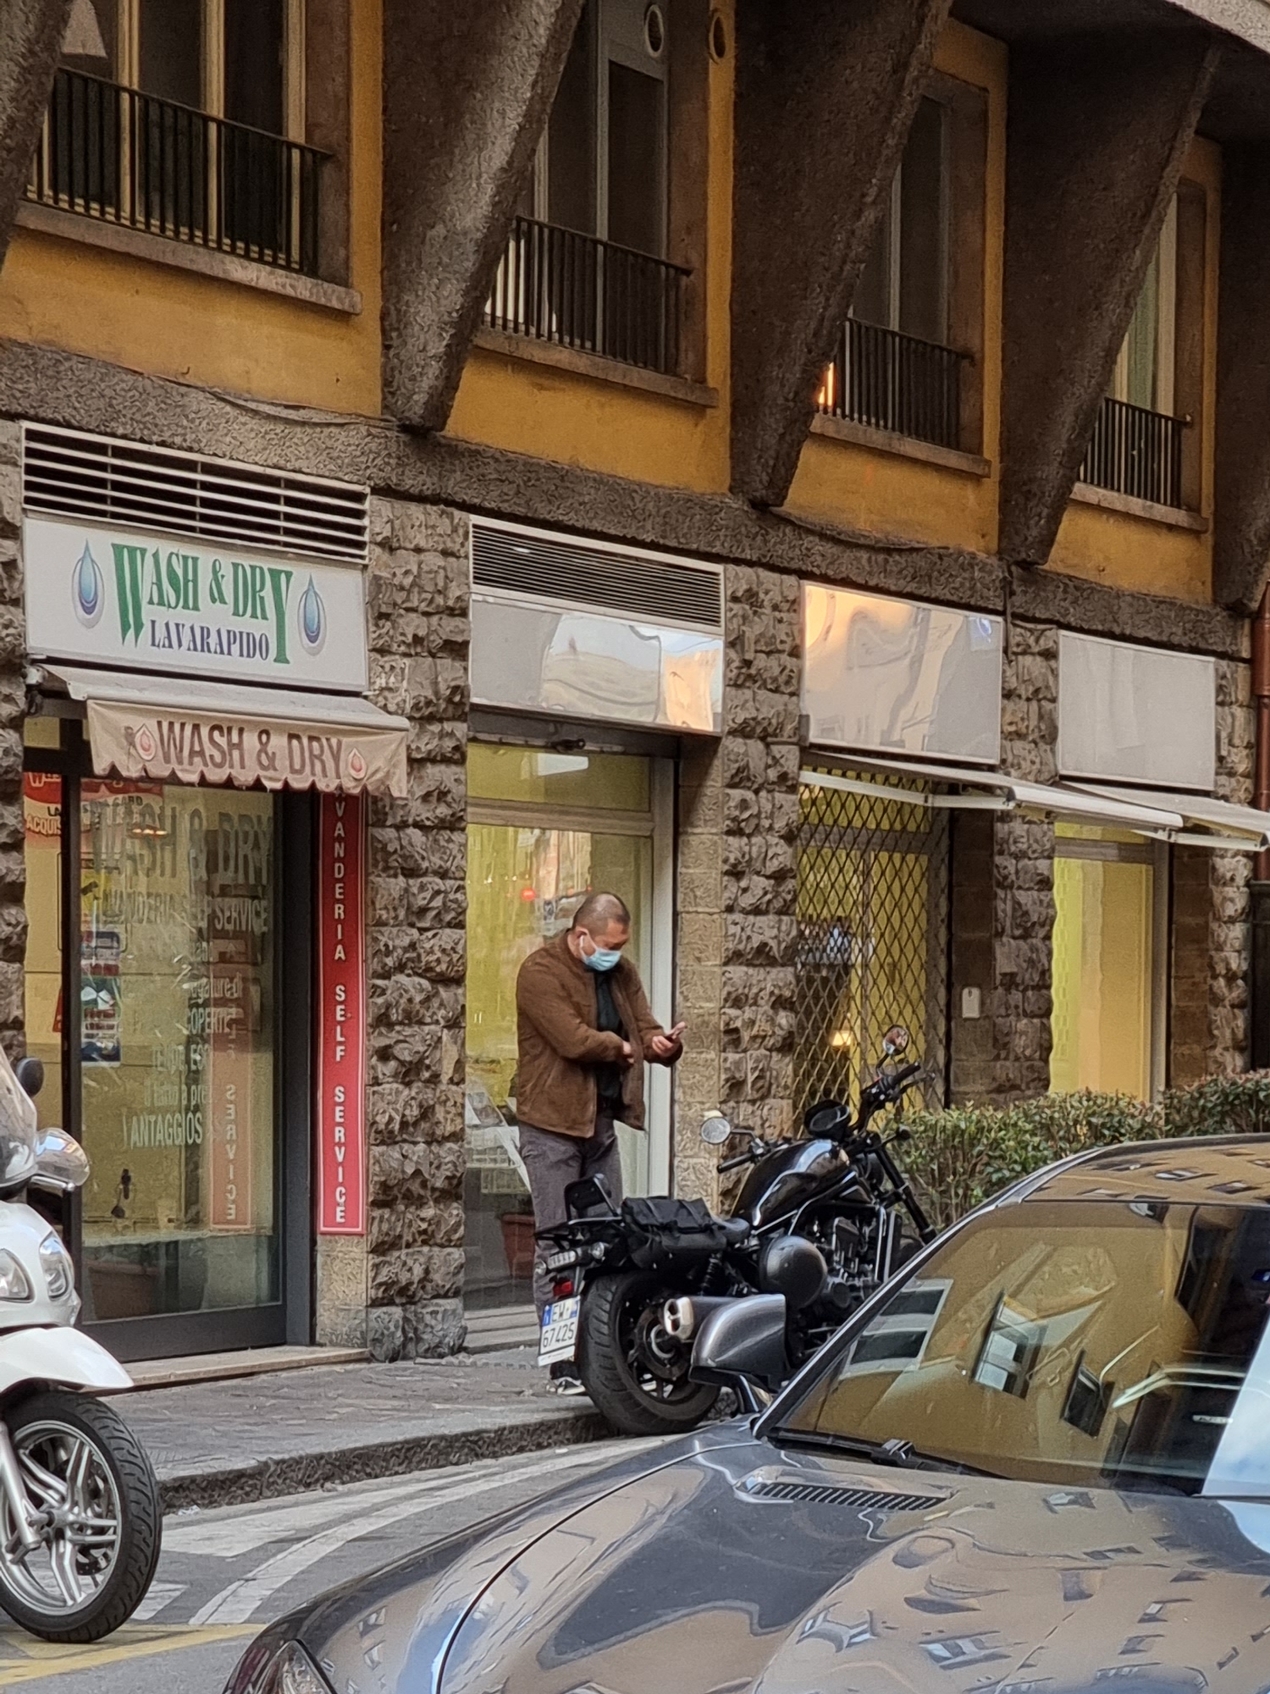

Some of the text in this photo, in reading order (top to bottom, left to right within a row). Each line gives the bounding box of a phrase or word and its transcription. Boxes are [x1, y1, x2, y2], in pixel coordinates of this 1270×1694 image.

[111, 543, 293, 665] WASH & DRY
[150, 618, 270, 661] LAVARAPIDO
[156, 720, 344, 780] WASH & DRY
[335, 985, 346, 1062] SELF
[334, 1086, 346, 1223] SERVICE
[542, 1322, 575, 1348] 67425
